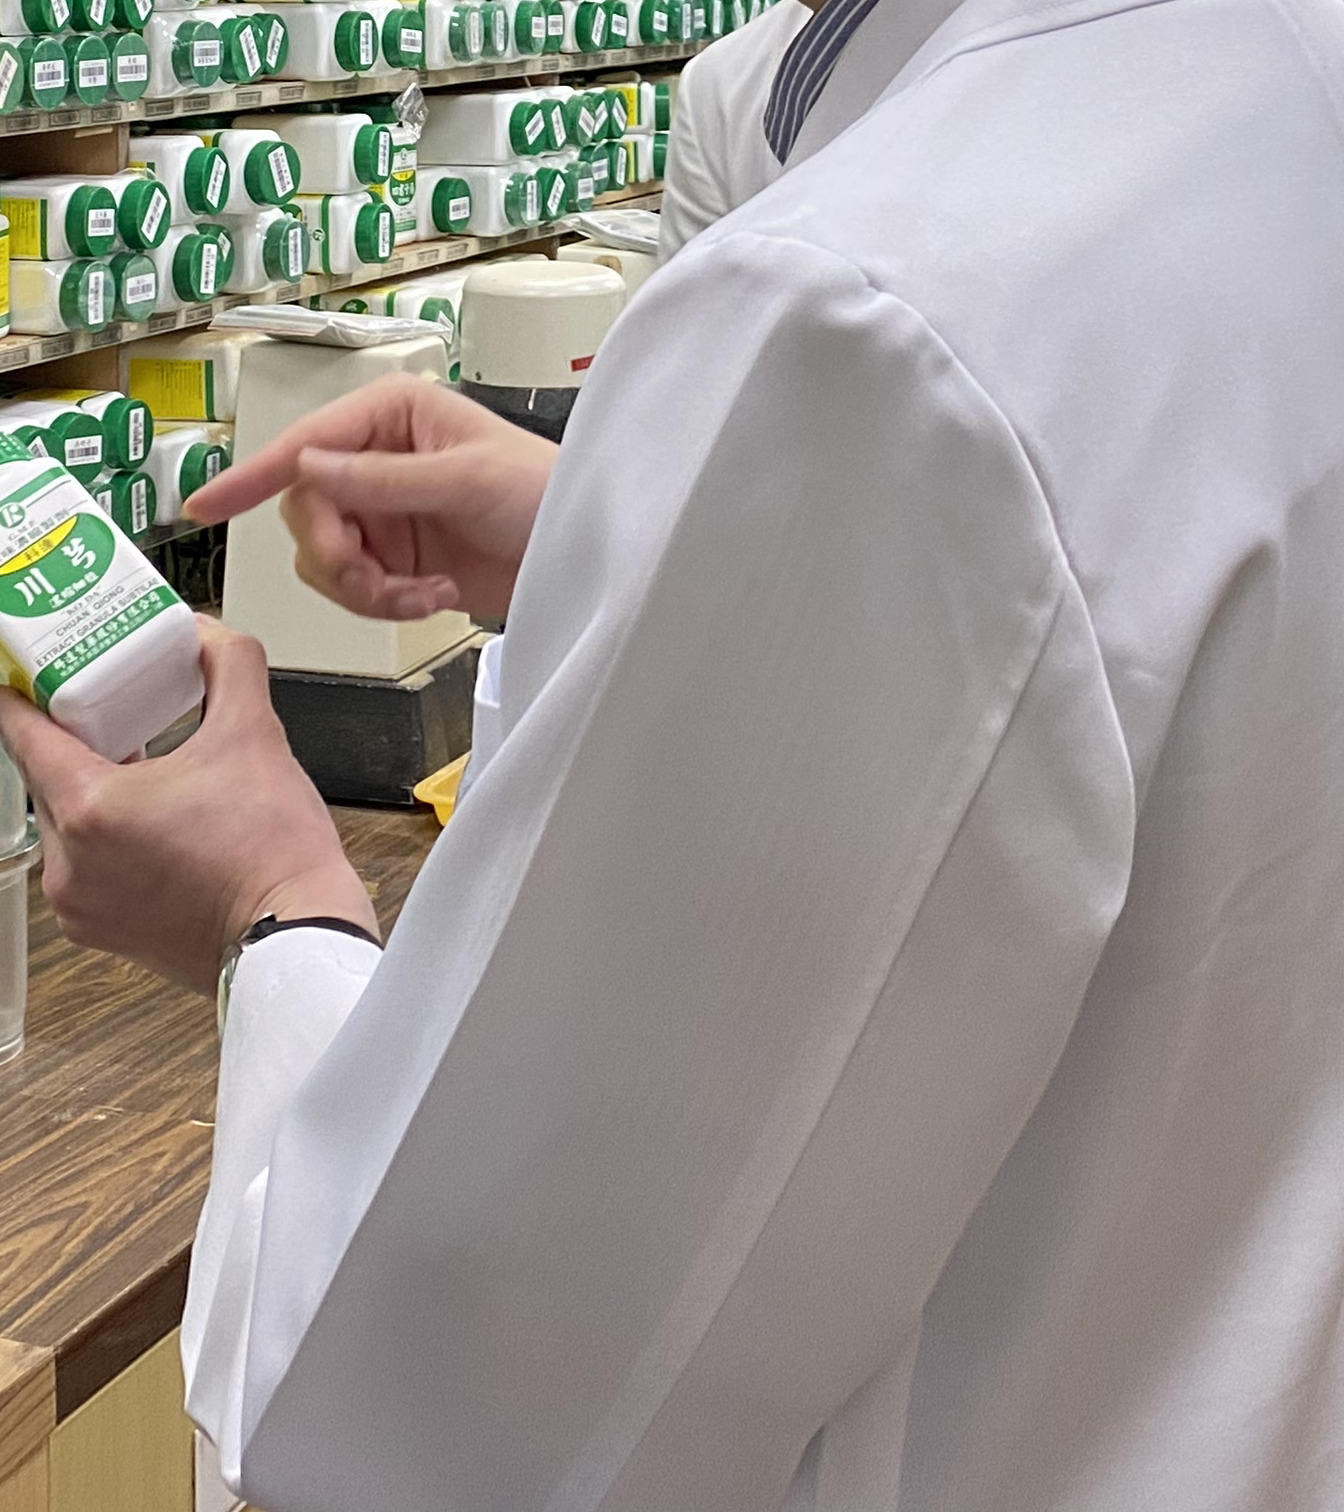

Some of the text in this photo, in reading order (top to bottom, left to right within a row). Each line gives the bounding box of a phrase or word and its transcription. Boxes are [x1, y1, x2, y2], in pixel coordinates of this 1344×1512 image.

[13, 537, 97, 607] 川芎
[36, 636, 77, 667] EXTRACT
[77, 607, 119, 636] GRANULA
[56, 585, 126, 636] CHUAN QIONG
